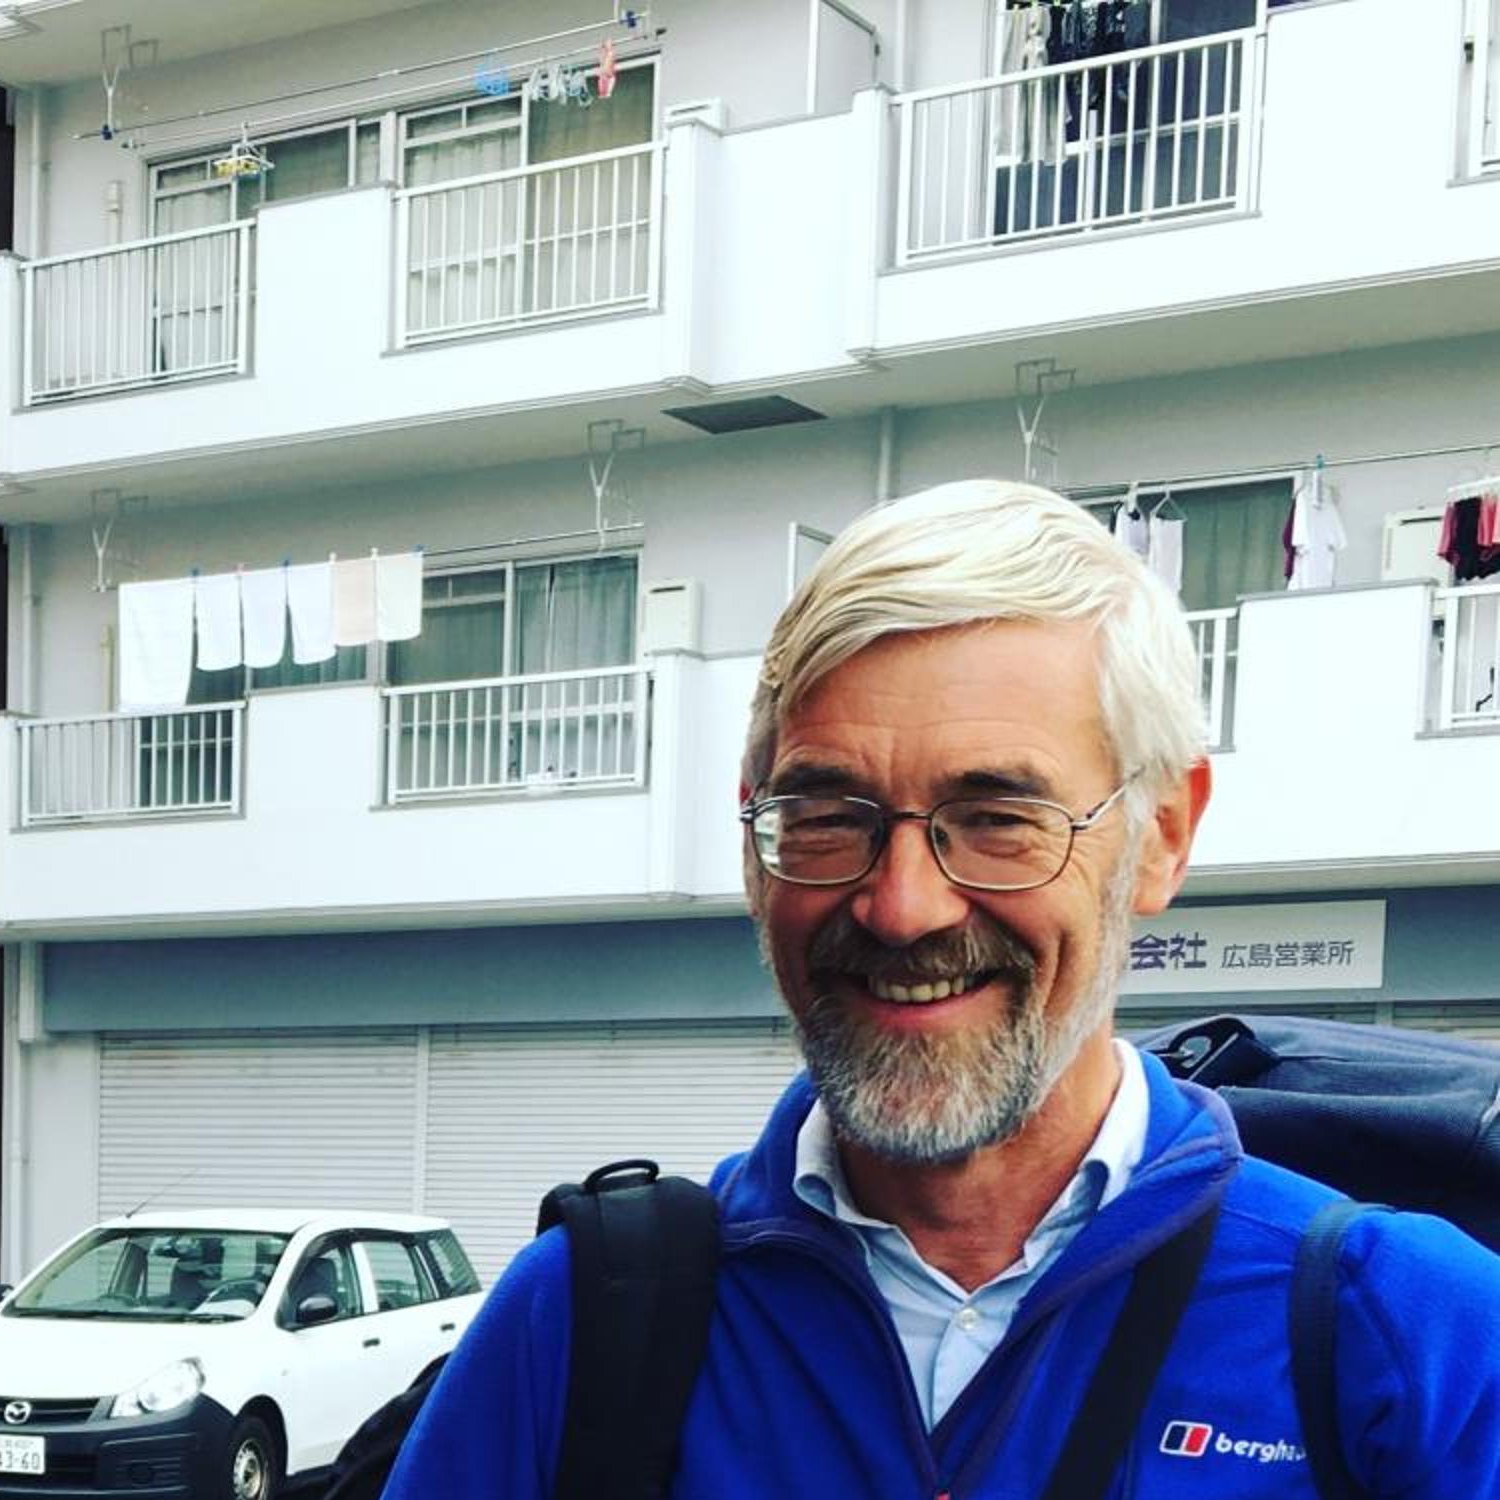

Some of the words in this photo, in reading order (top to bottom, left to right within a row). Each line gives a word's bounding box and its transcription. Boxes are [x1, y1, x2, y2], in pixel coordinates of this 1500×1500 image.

[1129, 931, 1208, 970] 会社
[1220, 939, 1356, 969] 広島営業所
